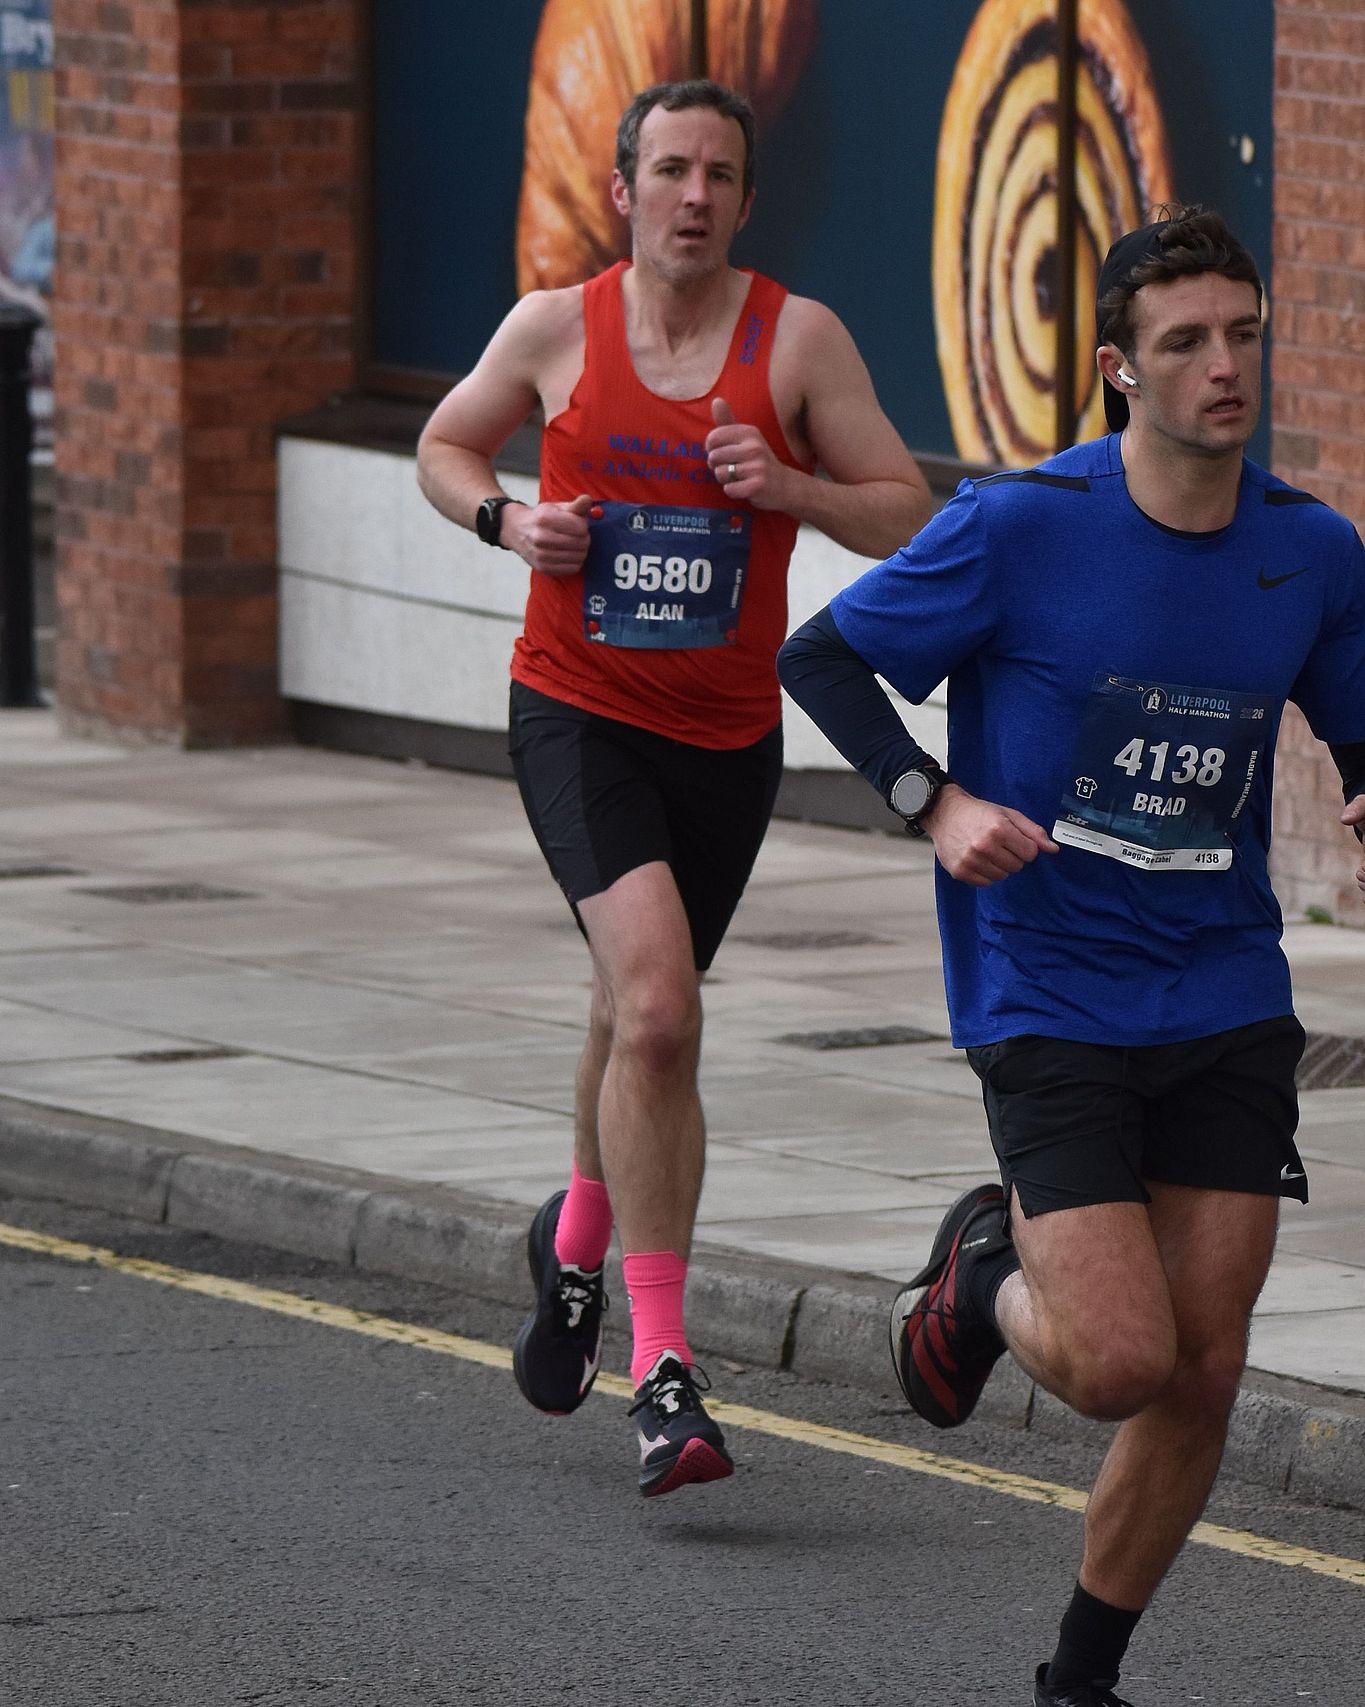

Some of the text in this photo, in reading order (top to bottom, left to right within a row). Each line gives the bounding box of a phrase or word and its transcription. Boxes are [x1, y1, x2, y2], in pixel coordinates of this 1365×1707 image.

[608, 434, 708, 461] WALLAS
[653, 514, 711, 528] LIVERPOOL
[672, 527, 711, 535] MARATHON
[614, 553, 712, 594] 9580
[635, 602, 685, 621] ALAN
[1170, 694, 1231, 711] LIVERPOOL
[1168, 706, 1230, 720] HALF MARATHON
[1113, 738, 1226, 787] 4138
[1246, 750, 1258, 782] BRADLEY
[1082, 785, 1089, 793] S
[1132, 793, 1187, 816] BRAD
[1122, 848, 1155, 864] Baggage
[1195, 853, 1219, 864] 4138
